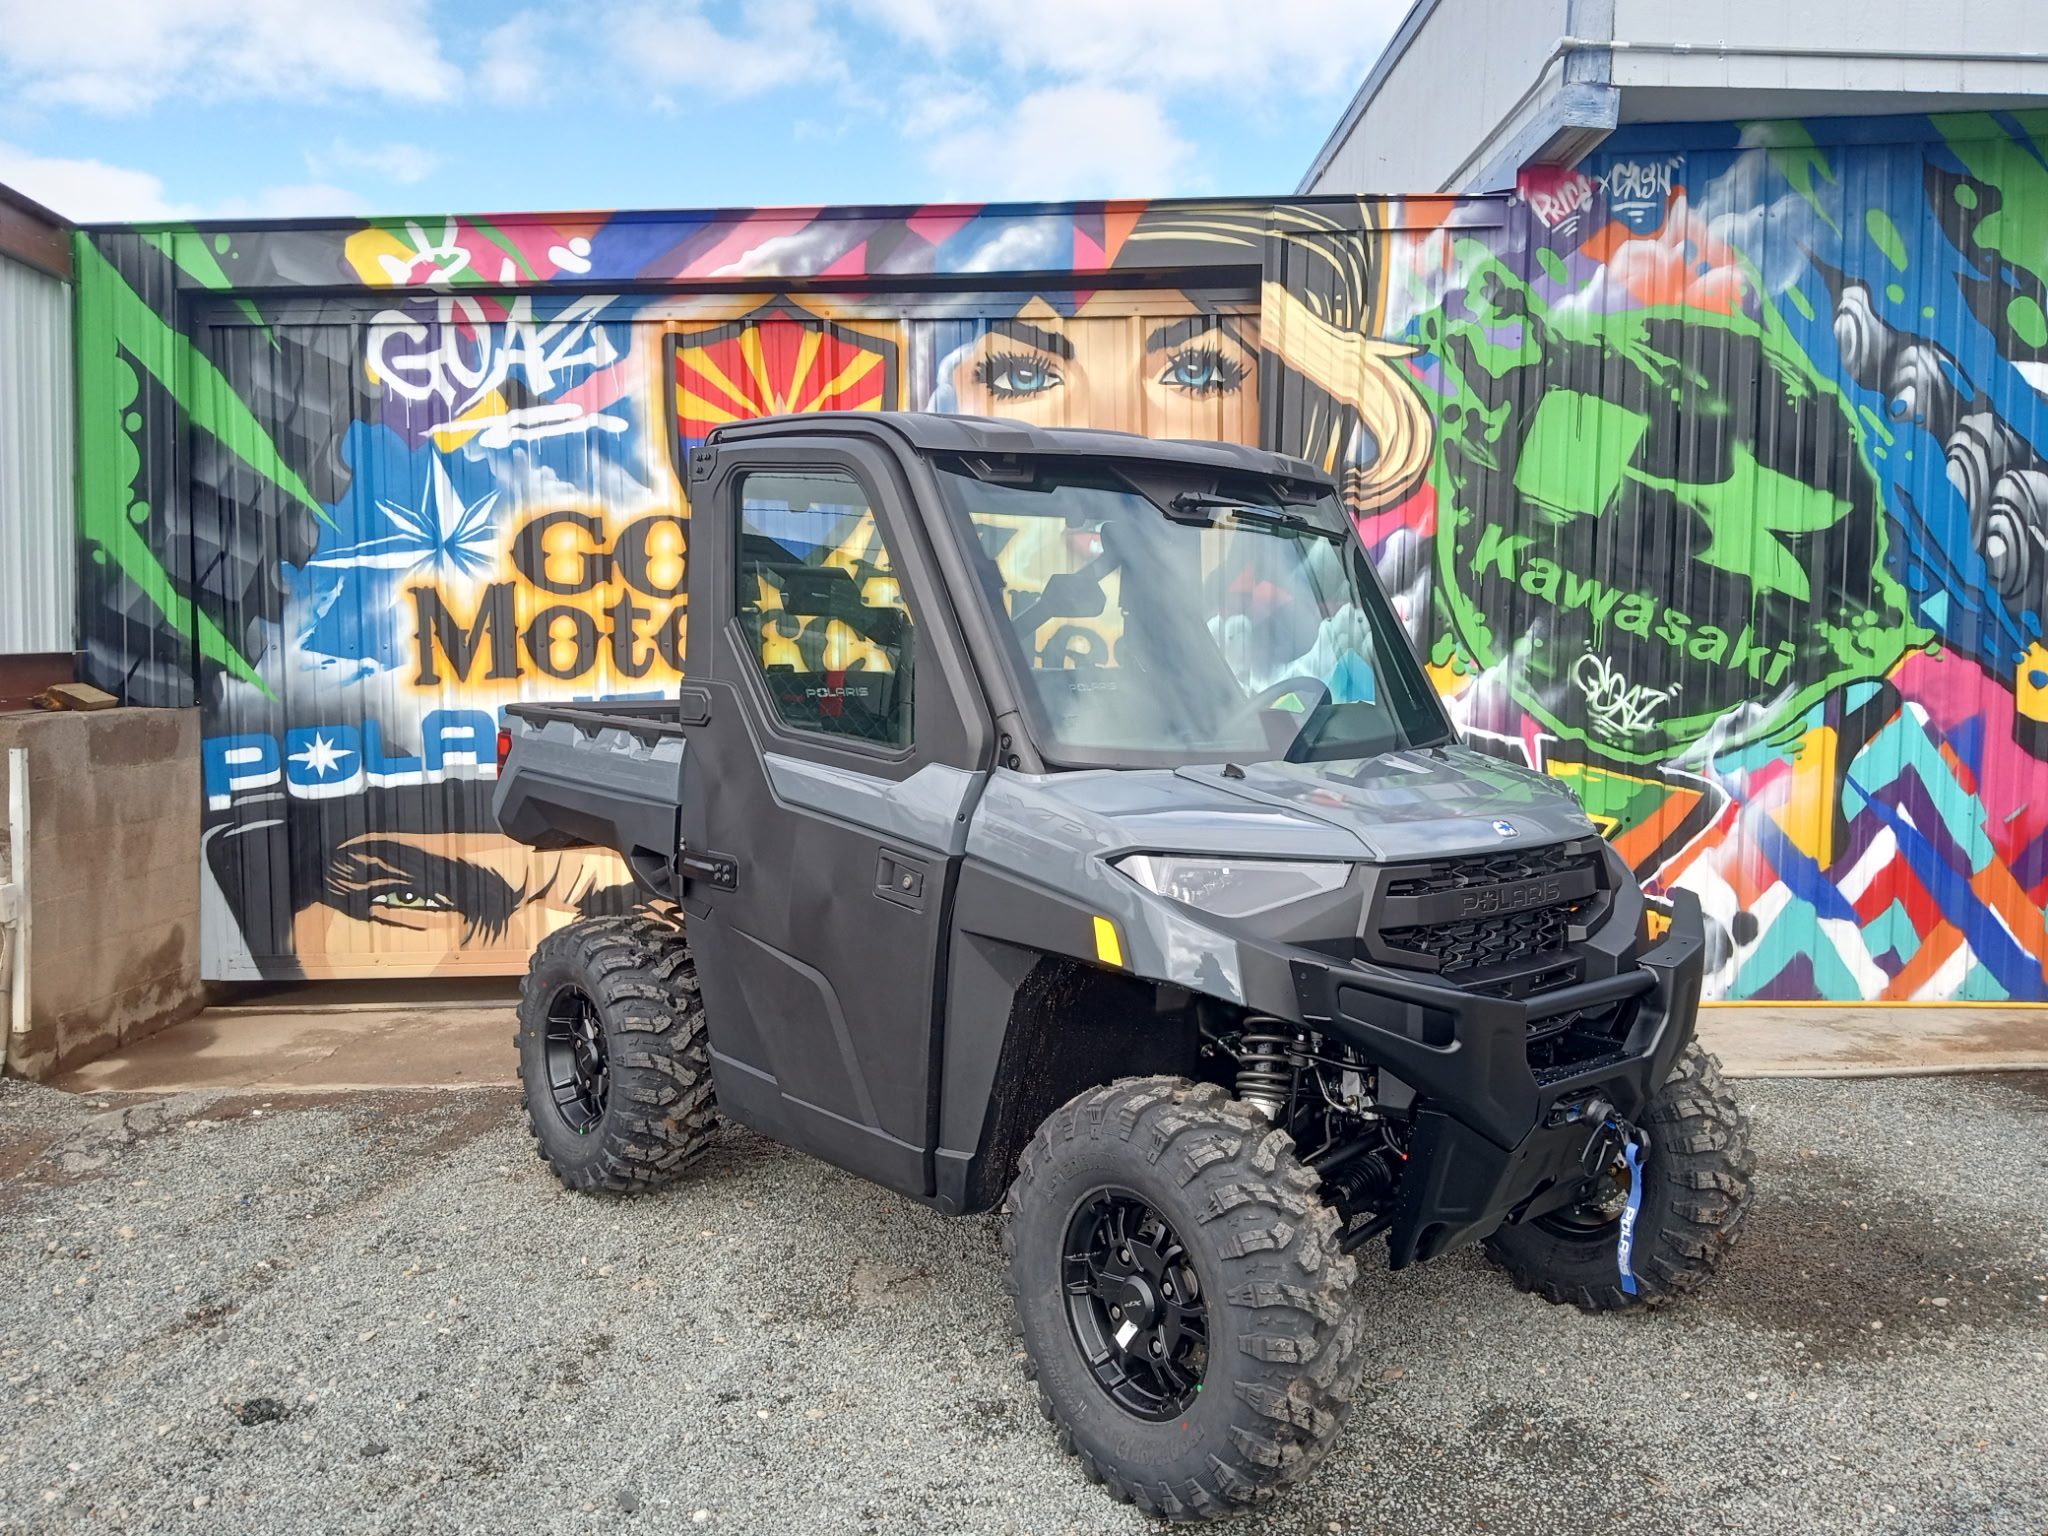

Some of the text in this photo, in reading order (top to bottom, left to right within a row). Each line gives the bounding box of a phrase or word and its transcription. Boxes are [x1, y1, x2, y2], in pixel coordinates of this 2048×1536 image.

[1469, 523, 1796, 687] Kawasaki
[805, 686, 869, 698] POLARIS
[1460, 881, 1561, 917] POLARIS
[1617, 1205, 1636, 1277] POLARIS
